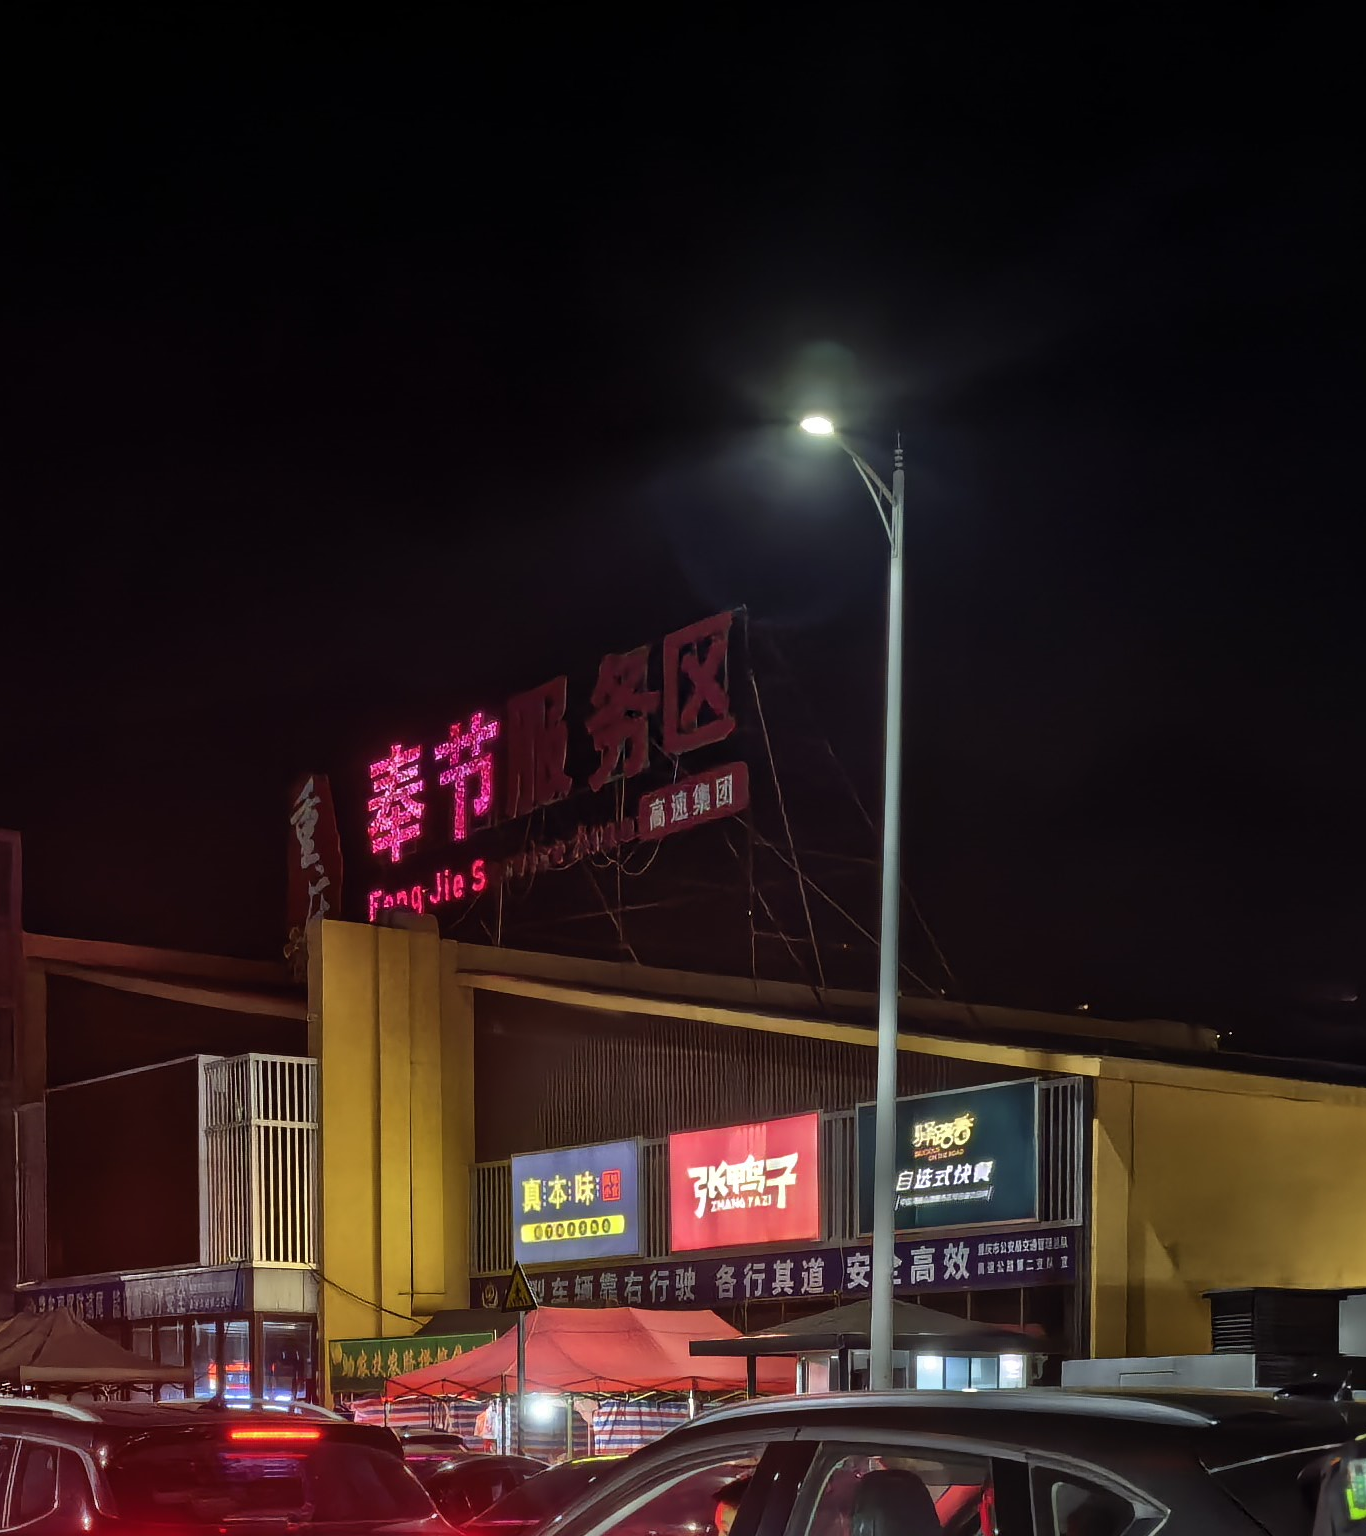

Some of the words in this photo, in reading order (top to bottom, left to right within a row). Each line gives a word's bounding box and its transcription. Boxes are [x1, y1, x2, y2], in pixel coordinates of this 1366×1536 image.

[368, 611, 736, 862] 奉节服务区
[649, 773, 733, 831] 高速集团
[430, 869, 464, 904] Jie
[522, 1171, 595, 1213] 真本味
[687, 1152, 798, 1219] 张鸭子
[715, 1257, 825, 1298] 各行其道
